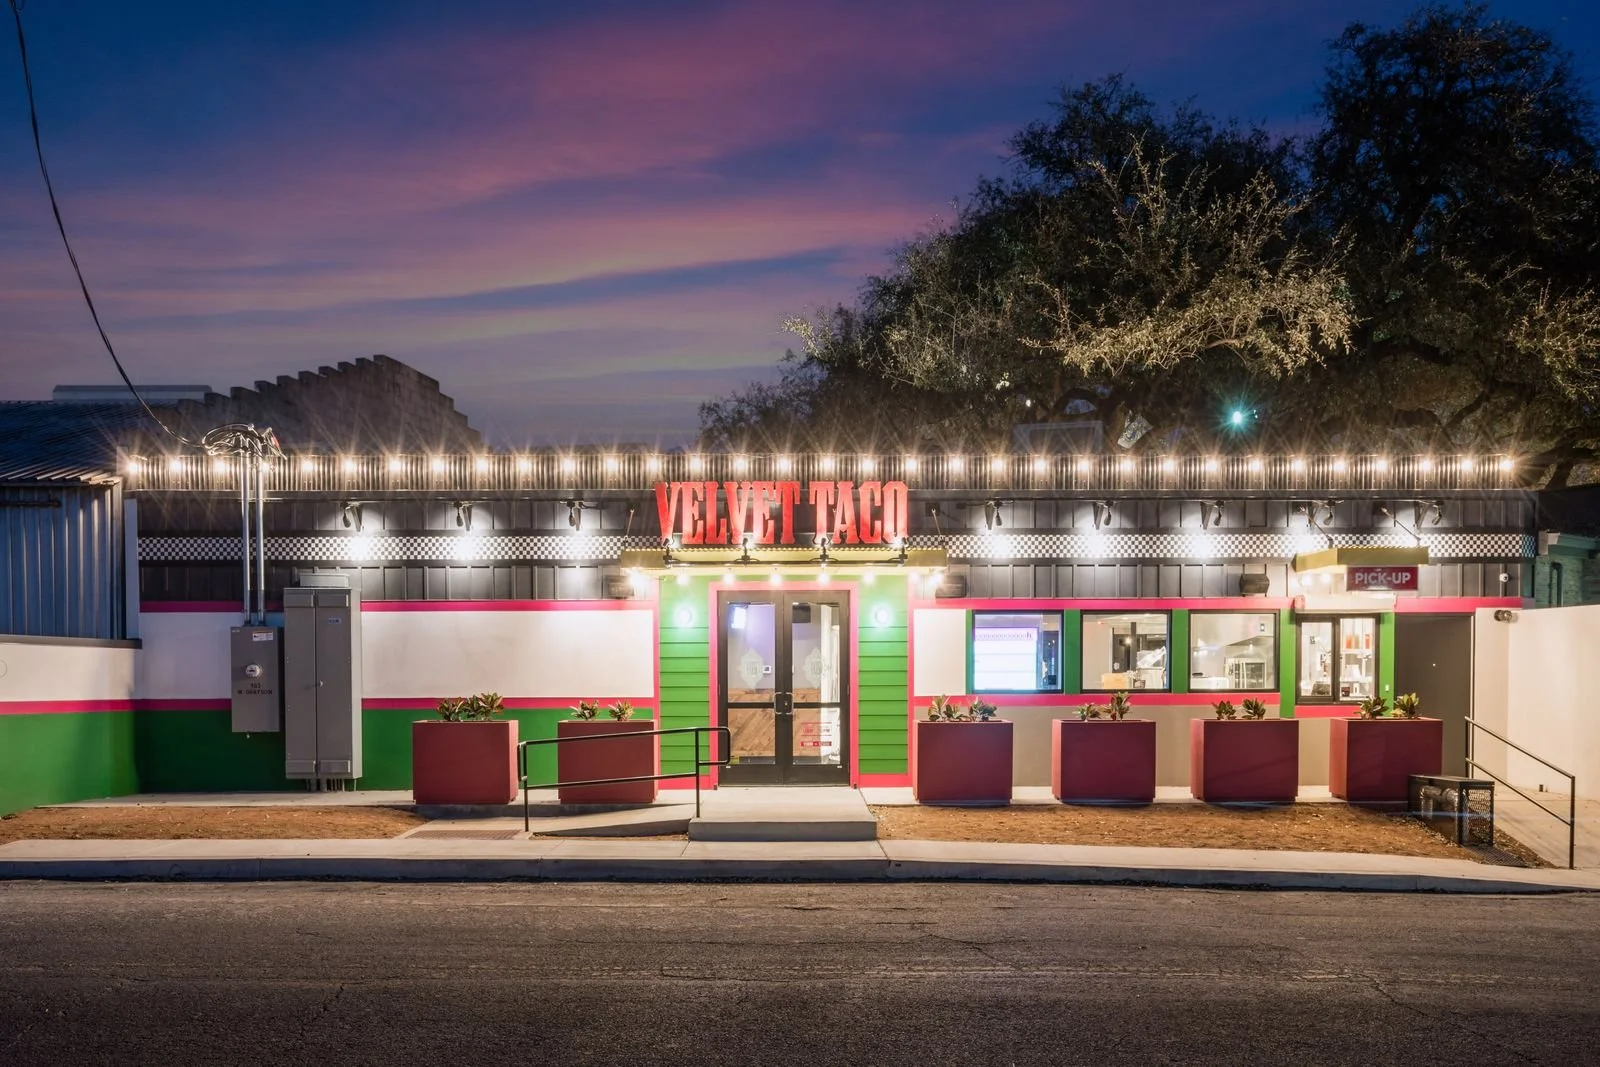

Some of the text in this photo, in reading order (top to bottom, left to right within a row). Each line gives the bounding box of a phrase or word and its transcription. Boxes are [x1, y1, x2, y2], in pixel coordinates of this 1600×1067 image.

[655, 480, 909, 545] VELVET TACO
[1355, 572, 1411, 585] PICK-UP
